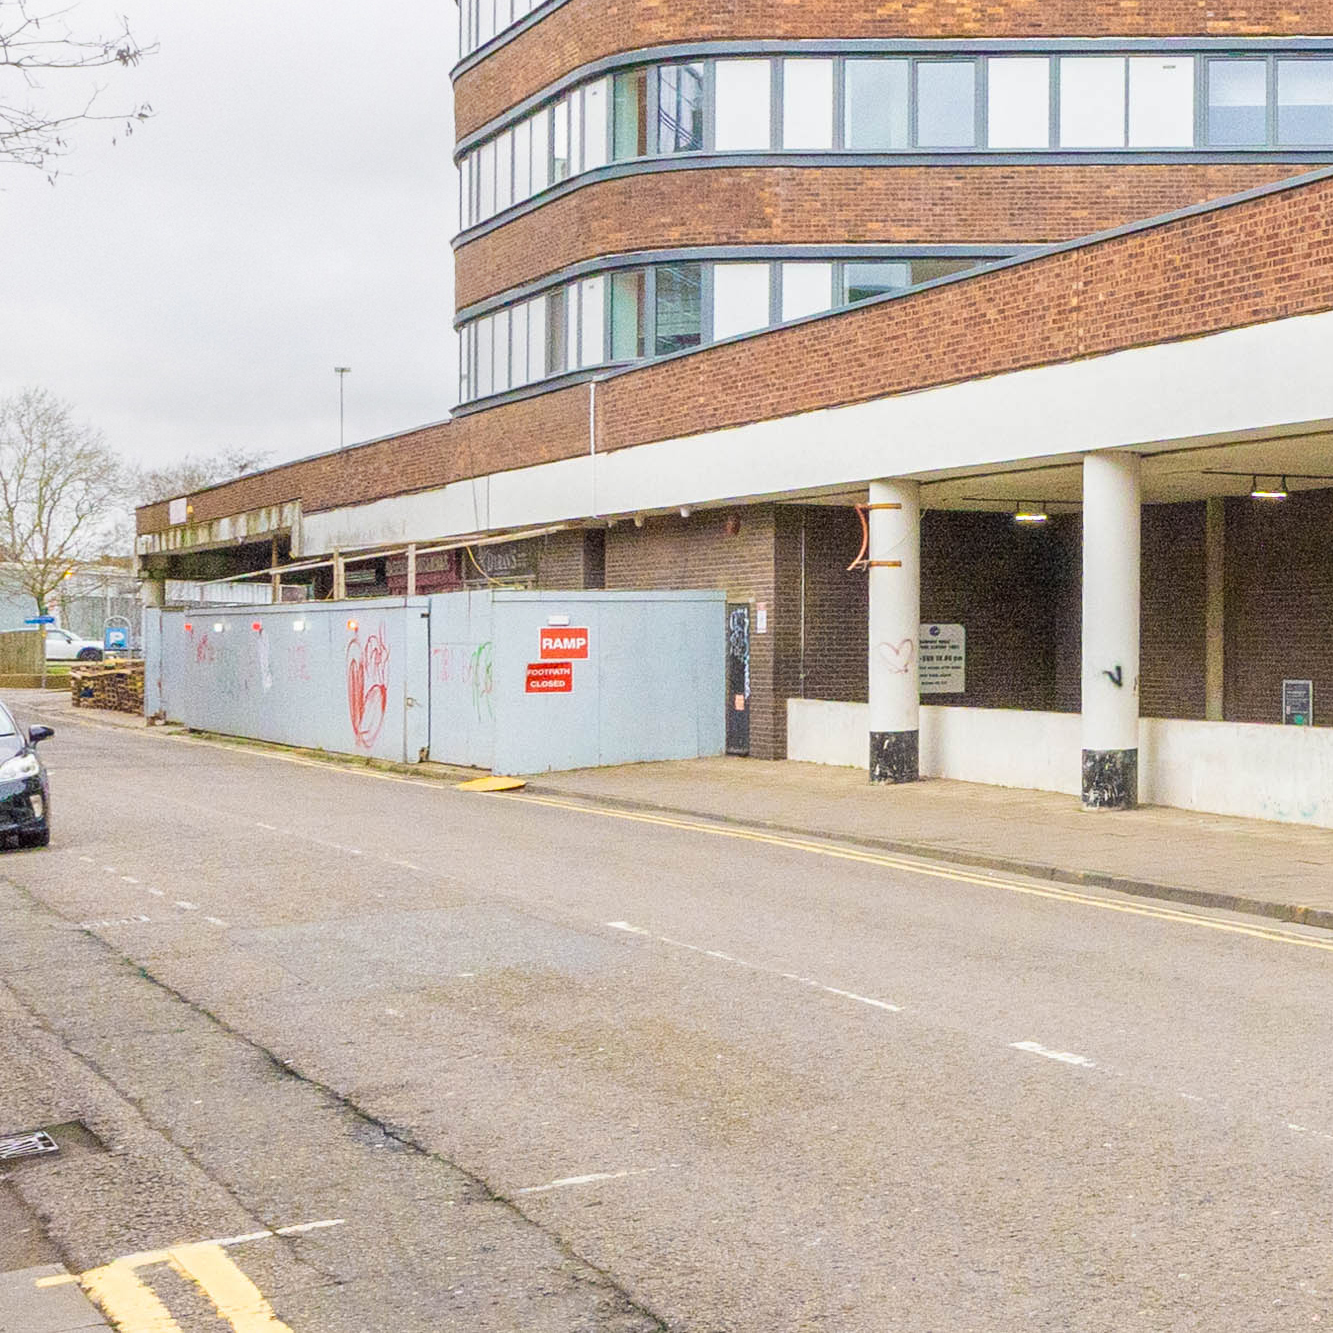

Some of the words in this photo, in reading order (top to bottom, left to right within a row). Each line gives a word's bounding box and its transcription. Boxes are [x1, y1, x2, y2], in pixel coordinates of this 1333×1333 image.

[542, 637, 586, 650] RAMP
[528, 668, 571, 676] FOOTPATH
[530, 680, 566, 688] CLOSED
